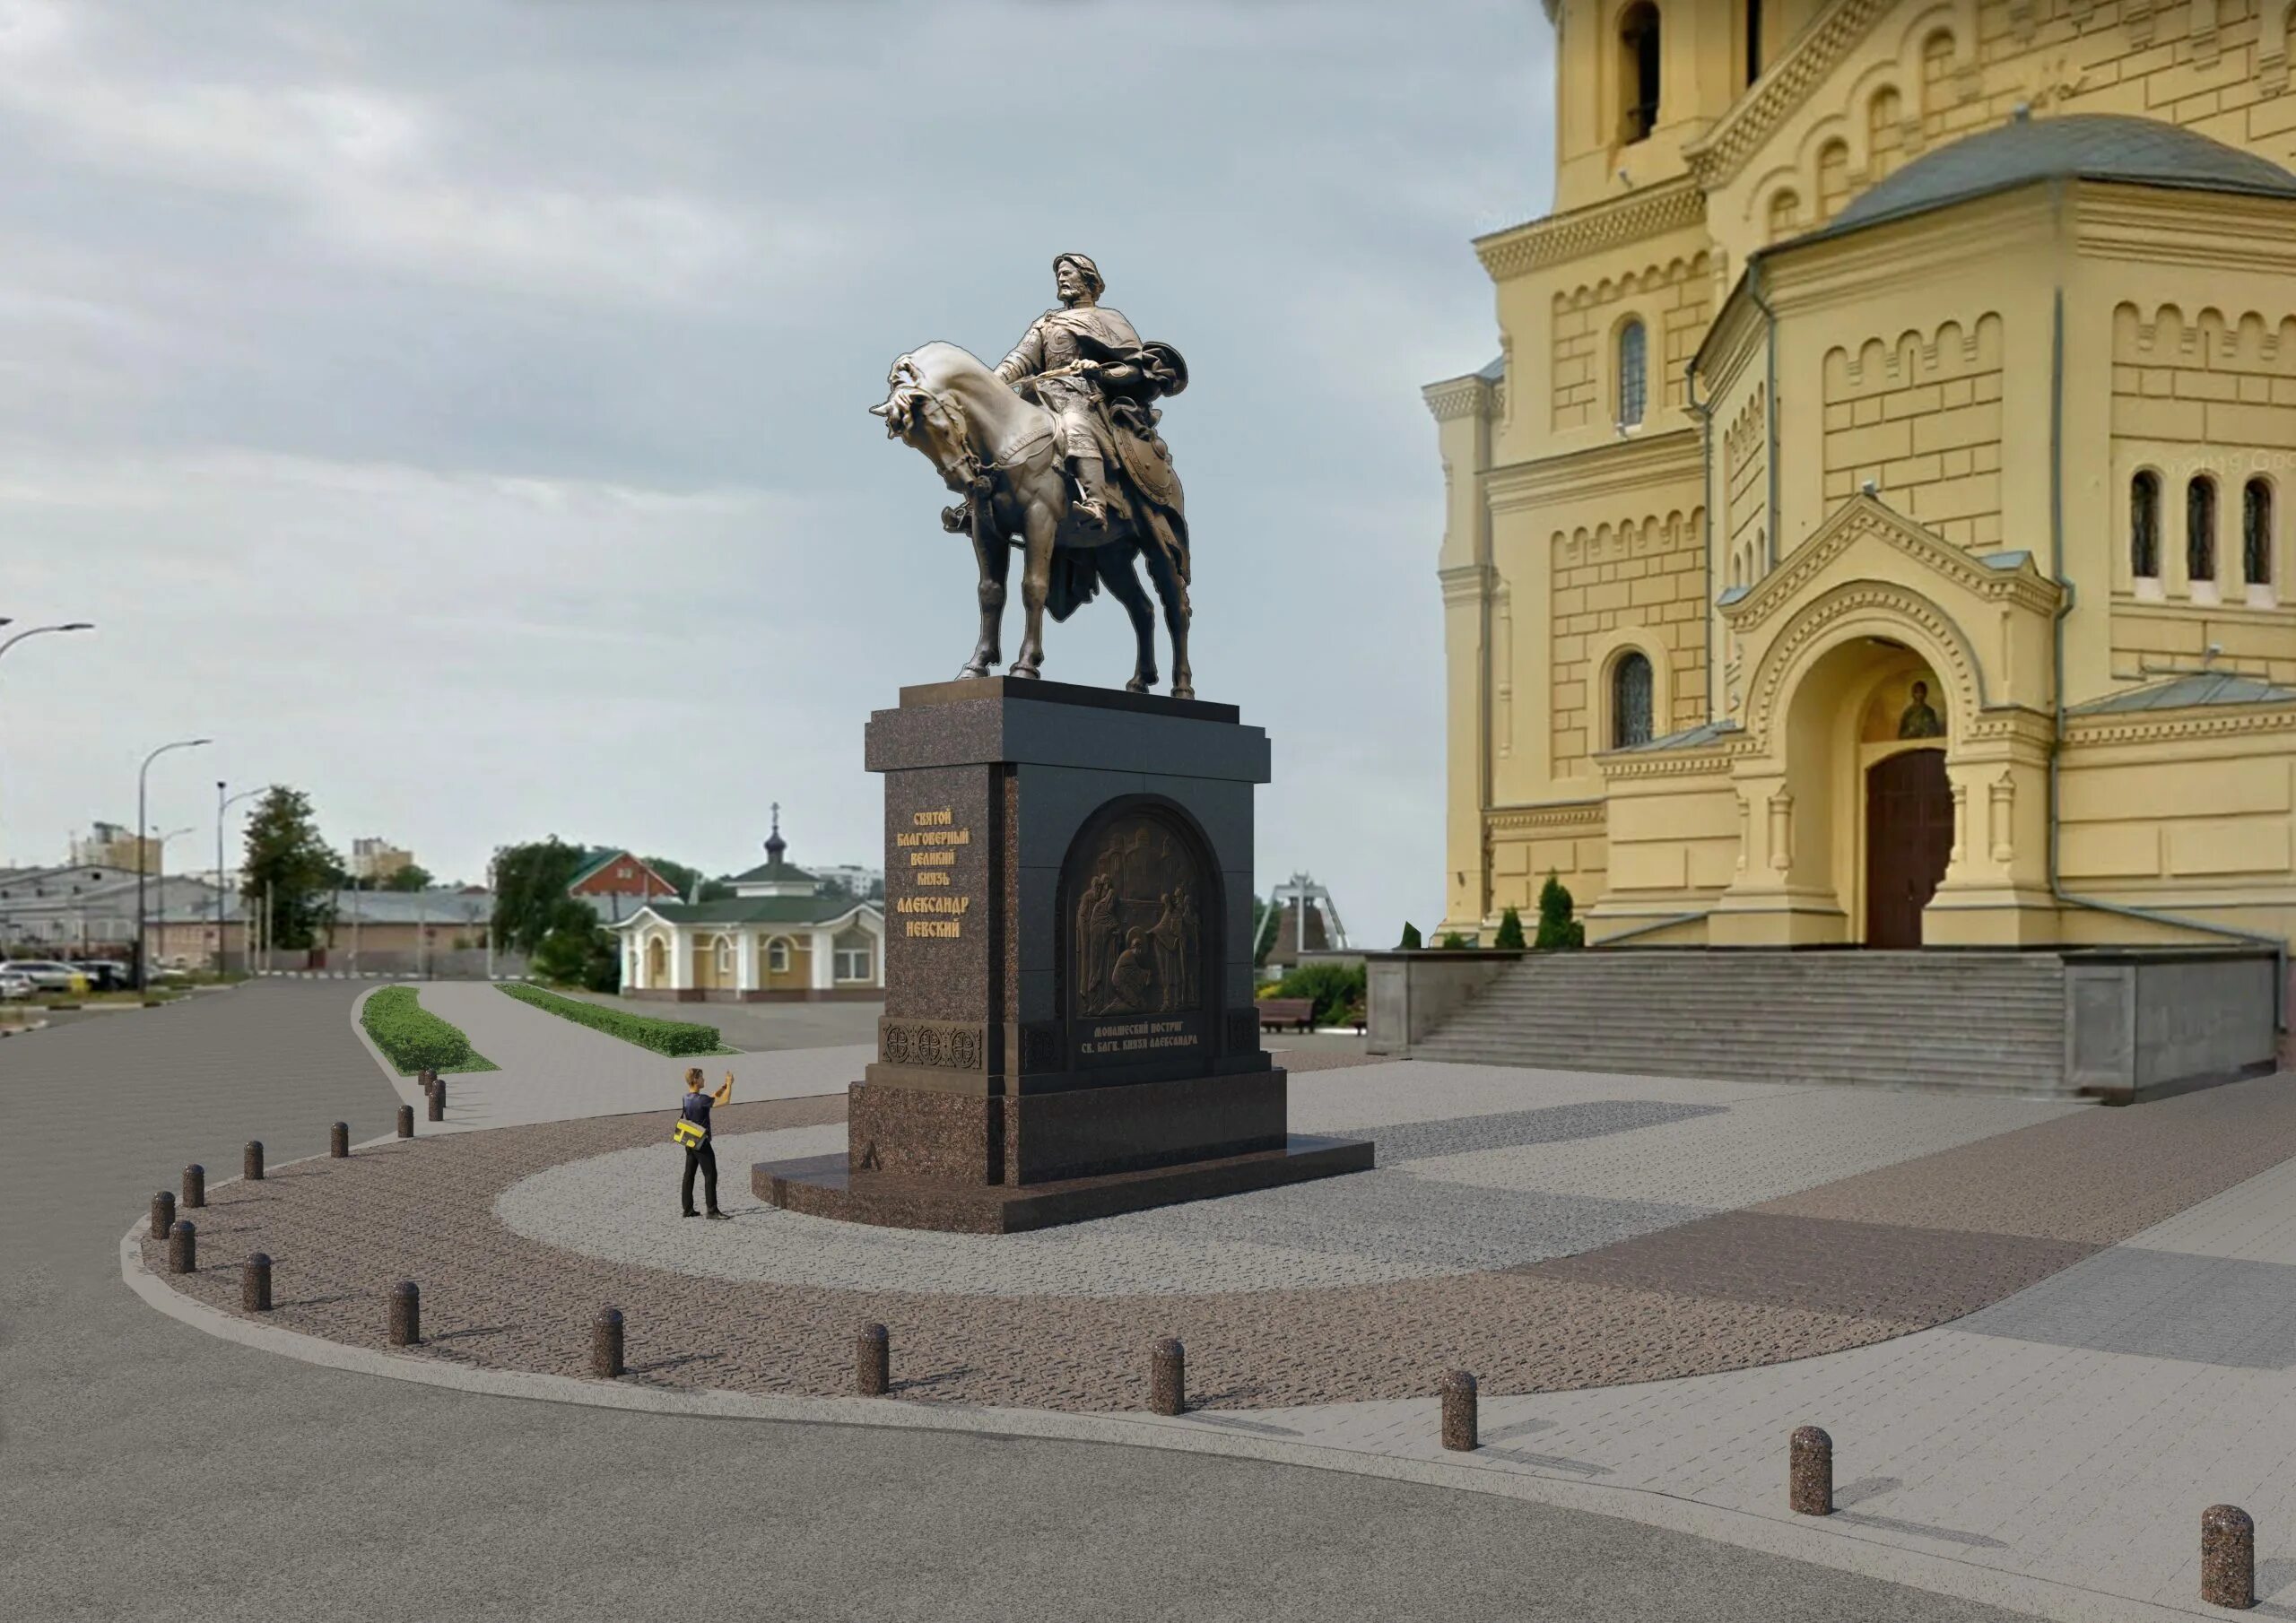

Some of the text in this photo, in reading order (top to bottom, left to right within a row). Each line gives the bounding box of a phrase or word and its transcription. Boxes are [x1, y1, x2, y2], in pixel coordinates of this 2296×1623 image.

[914, 805, 952, 825] СВЯТОЙ
[898, 828, 970, 846] БЛАГОВЕРНЫЙ
[911, 849, 955, 865] ВЕЛИКИЙ
[918, 872, 951, 885] КНЯЗЬ
[897, 897, 970, 915] АЛЕКСАНДР
[906, 918, 960, 937] НЕВСКИЙ
[1094, 1021, 1184, 1037] МОНАШЕСКИЙ ПОСТРИГ
[1082, 1043, 1094, 1054] СВ.
[1123, 1038, 1147, 1050] КНЯЗЯ
[1150, 1035, 1198, 1047] АЛЕКСАНДРА
